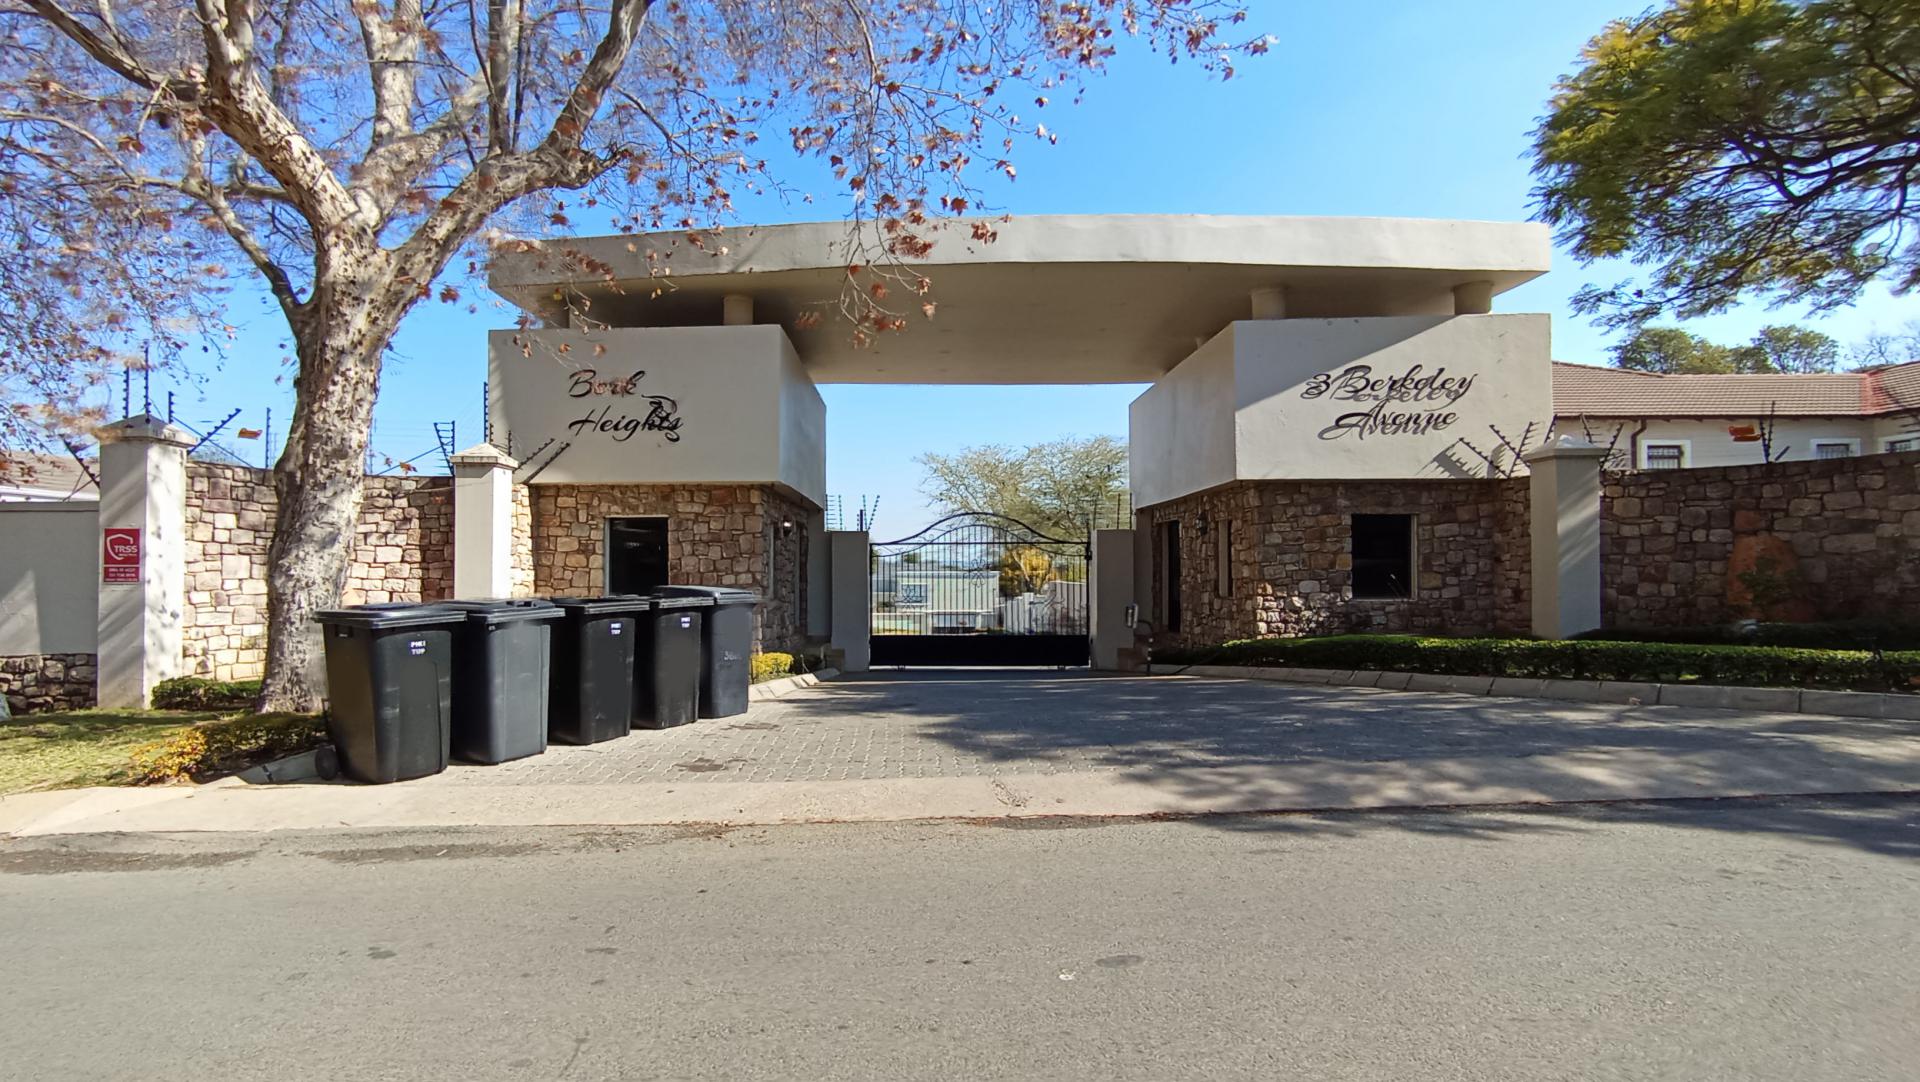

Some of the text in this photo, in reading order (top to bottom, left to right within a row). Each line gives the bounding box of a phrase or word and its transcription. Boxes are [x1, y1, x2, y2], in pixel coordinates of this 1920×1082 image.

[1305, 373, 1332, 397] 3
[1330, 399, 1459, 430] Avenue
[113, 545, 138, 553] TRSS
